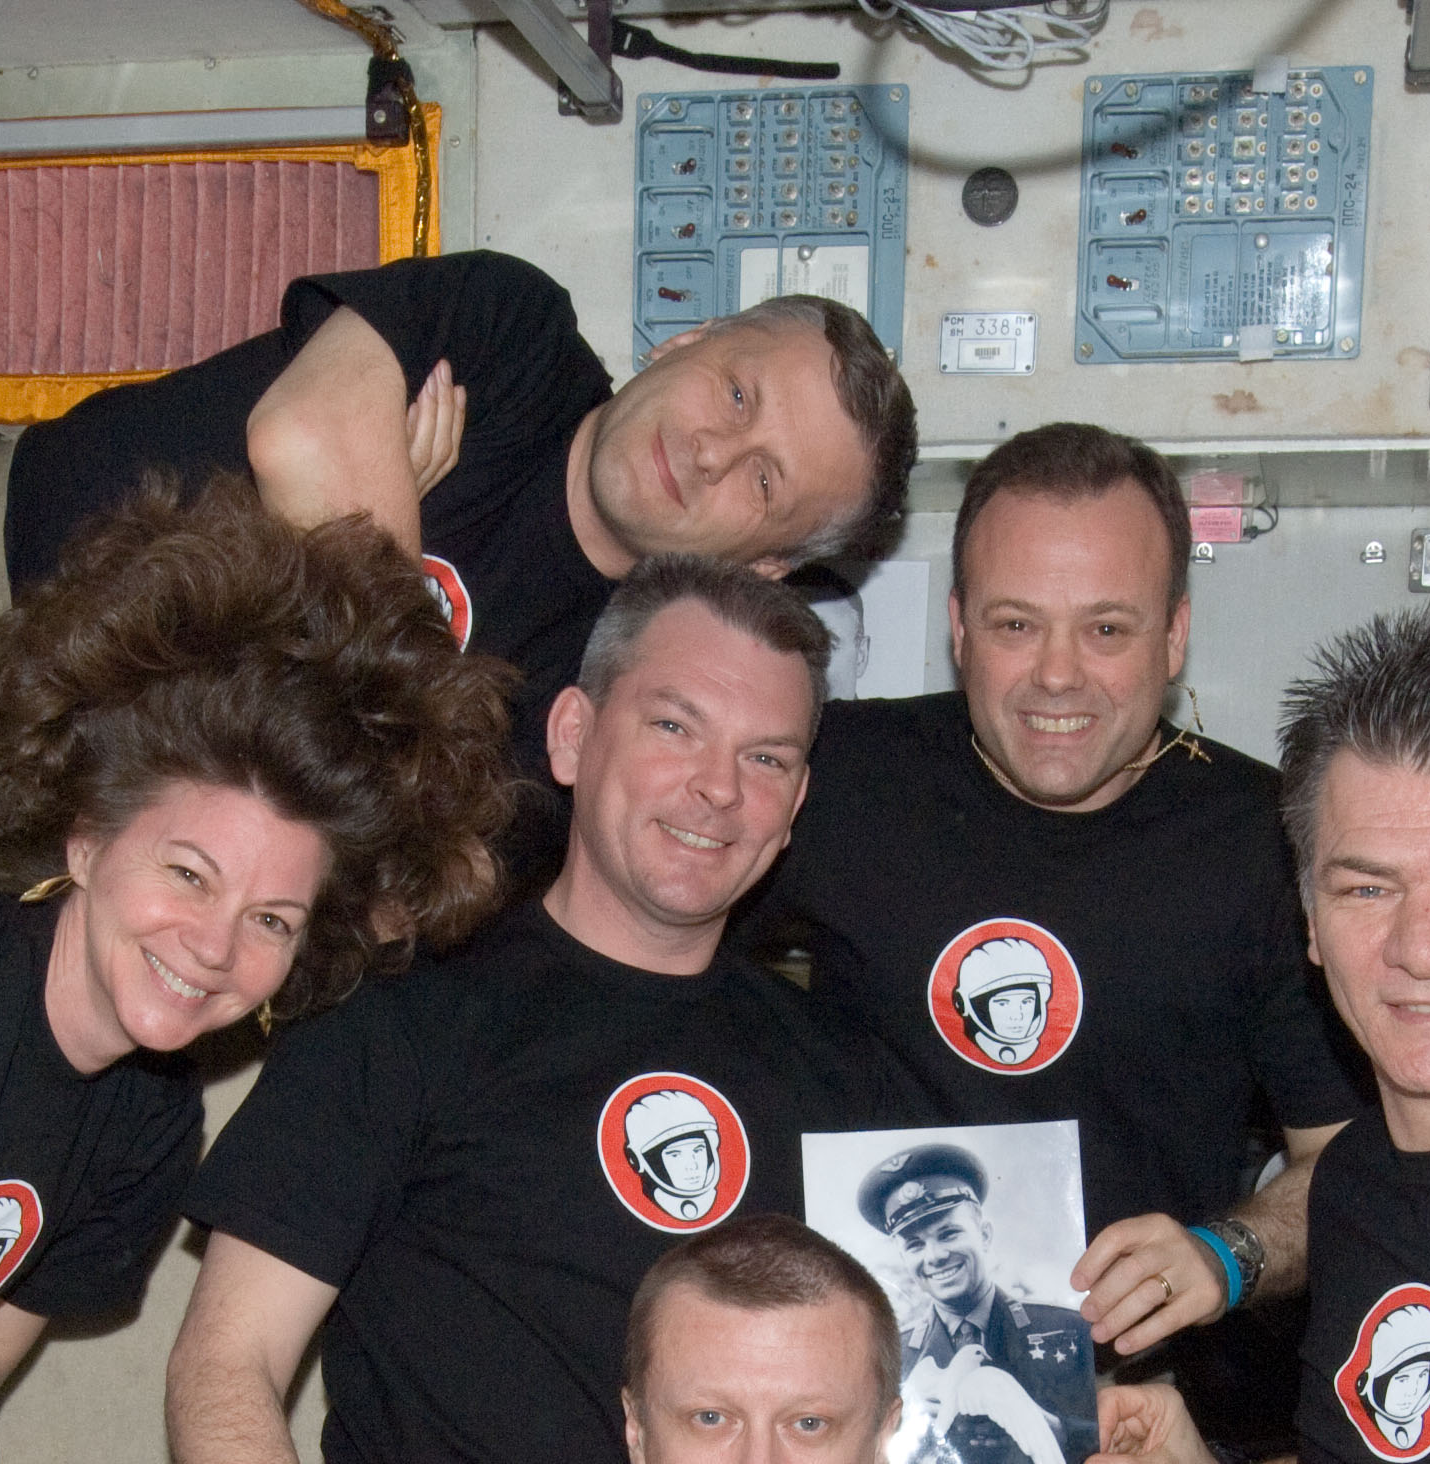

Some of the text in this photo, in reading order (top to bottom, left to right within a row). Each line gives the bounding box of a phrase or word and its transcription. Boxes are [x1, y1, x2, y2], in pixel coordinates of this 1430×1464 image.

[881, 187, 895, 240] ППС-23
[1342, 173, 1356, 227] ППС-24
[975, 318, 1010, 336] 338
